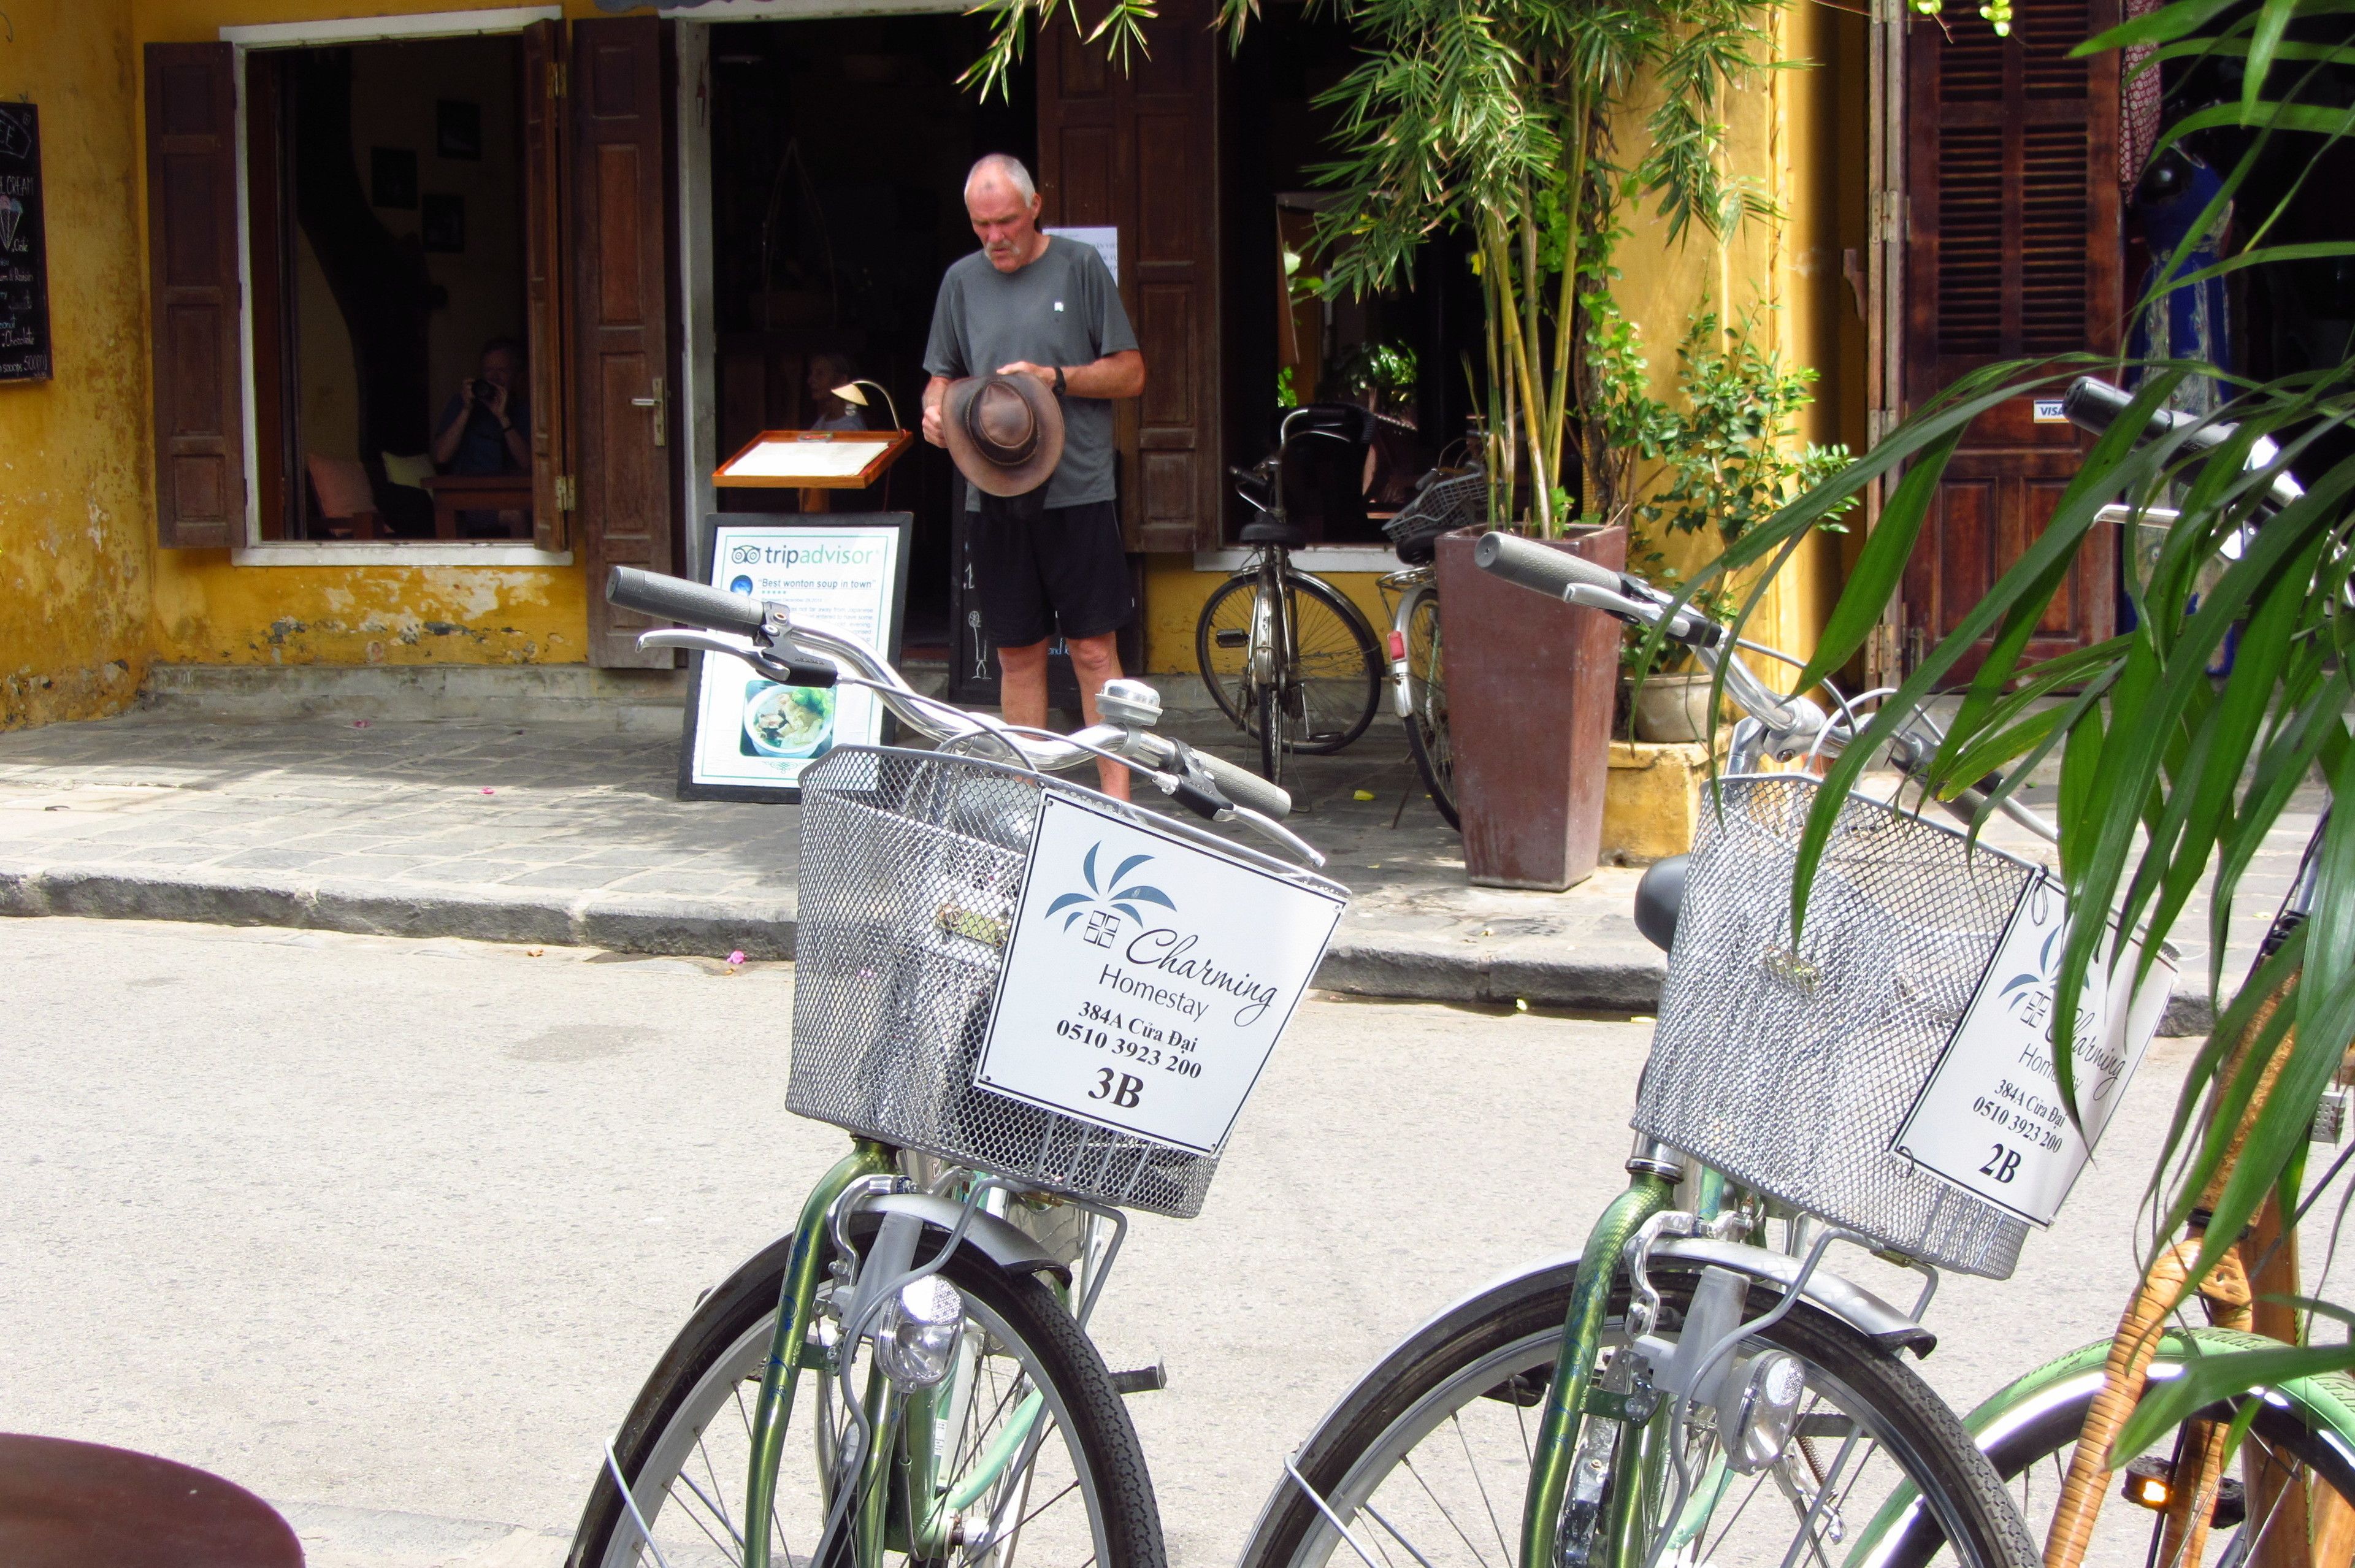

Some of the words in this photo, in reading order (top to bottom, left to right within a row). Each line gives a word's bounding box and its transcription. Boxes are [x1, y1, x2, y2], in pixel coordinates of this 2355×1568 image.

[2040, 407, 2063, 416] VISA
[765, 545, 874, 568] tripadvisor
[783, 579, 814, 588] wonton
[817, 581, 838, 589] soup
[841, 579, 848, 588] in
[1098, 963, 1209, 1023] Homestay
[1126, 928, 1277, 1027] Charming
[1056, 1019, 1108, 1049] 0510
[1111, 1038, 1162, 1066] 3923
[1165, 1055, 1201, 1079] 200
[1078, 1001, 1122, 1030] 384A
[1128, 1018, 1163, 1042] Cửa
[1167, 1030, 1198, 1054] Đại
[1087, 1067, 1144, 1109] 3B
[1994, 1079, 2025, 1107] 384A
[2026, 1095, 2047, 1119] Cửa
[2047, 1106, 2068, 1130] Đại
[1972, 1096, 2009, 1125] 0510
[2008, 1115, 2041, 1142] 3923
[2039, 1130, 2063, 1153] 200
[1978, 1142, 2021, 1184] 2B
